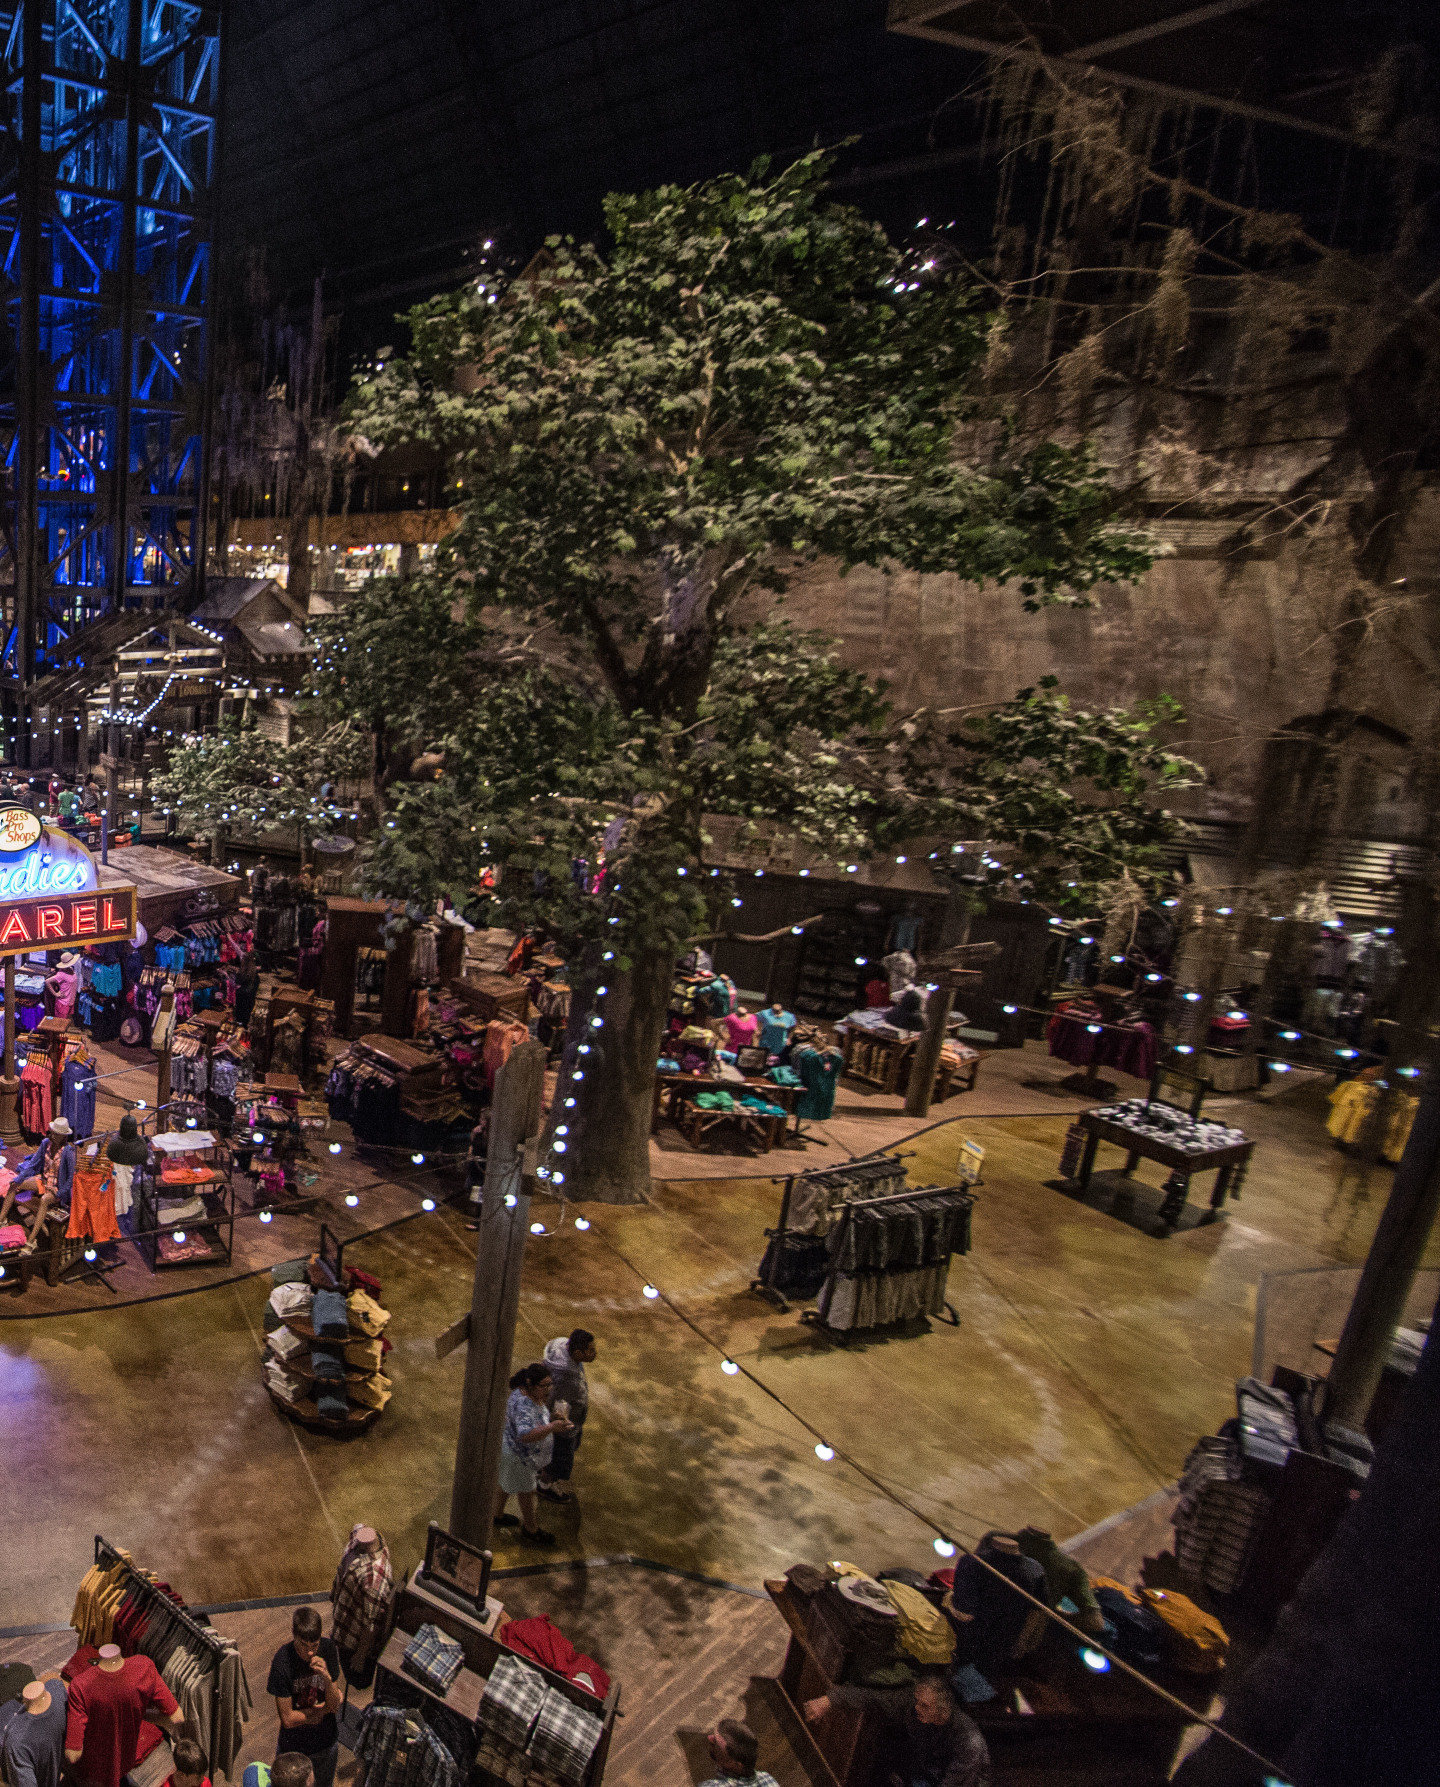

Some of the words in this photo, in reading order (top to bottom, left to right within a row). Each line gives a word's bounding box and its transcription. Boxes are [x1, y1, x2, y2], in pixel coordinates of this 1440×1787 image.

[5, 810, 29, 821] Bass
[6, 820, 24, 831] Pro
[6, 831, 37, 844] Shops
